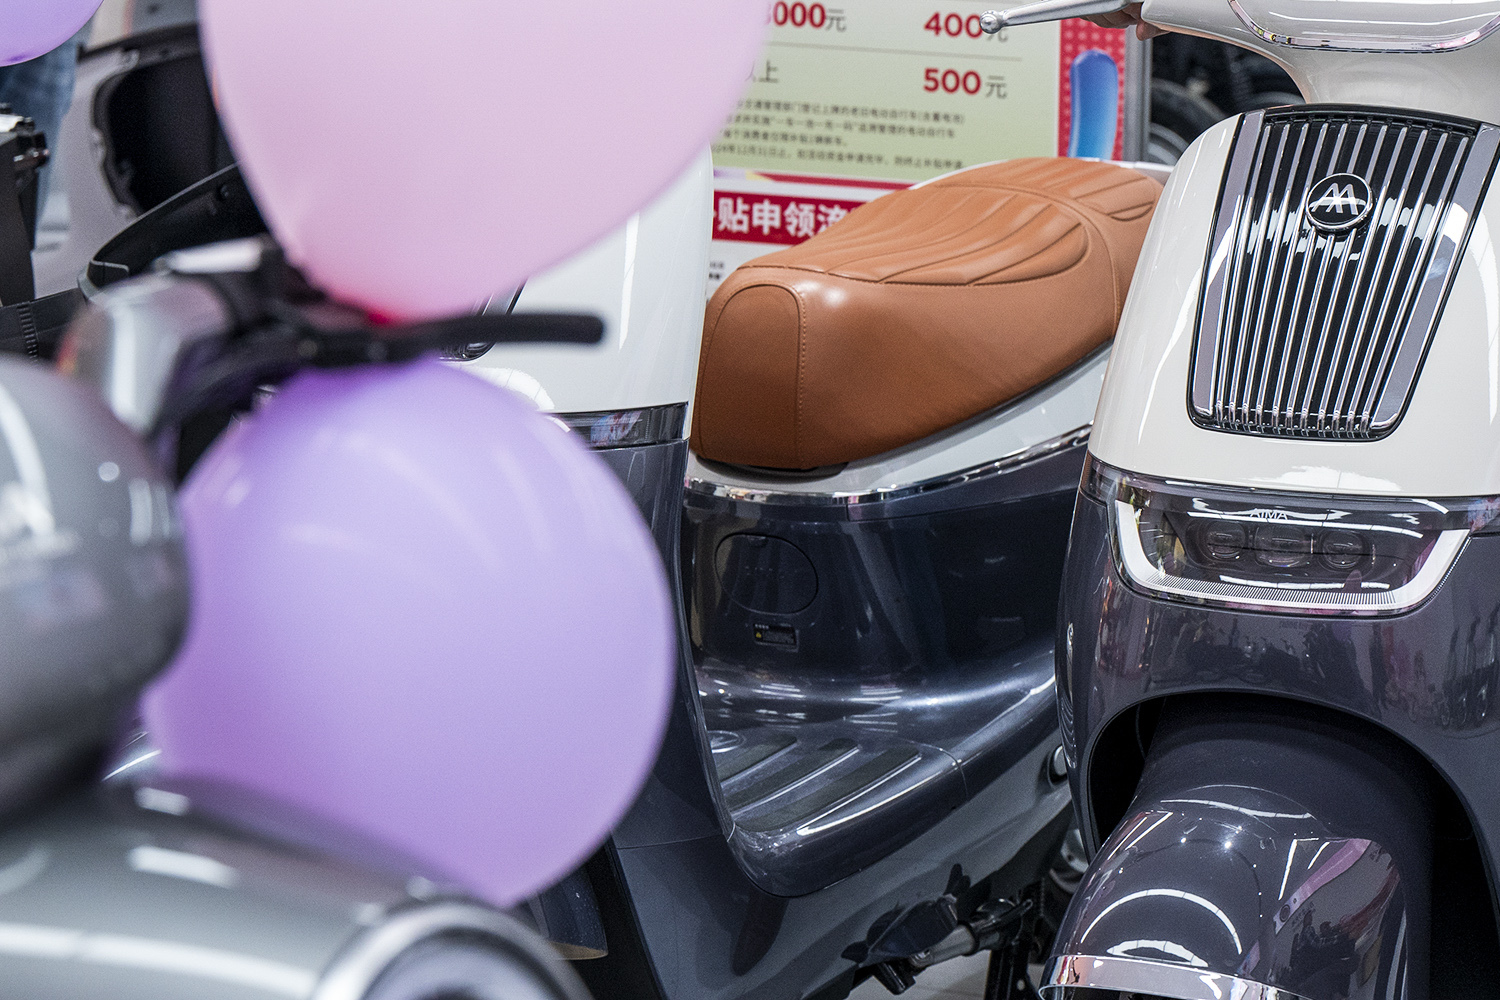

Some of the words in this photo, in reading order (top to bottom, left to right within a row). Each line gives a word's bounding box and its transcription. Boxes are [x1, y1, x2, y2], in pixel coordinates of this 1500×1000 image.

[923, 67, 1007, 100] 500元
[713, 197, 857, 237] 贴申领流
